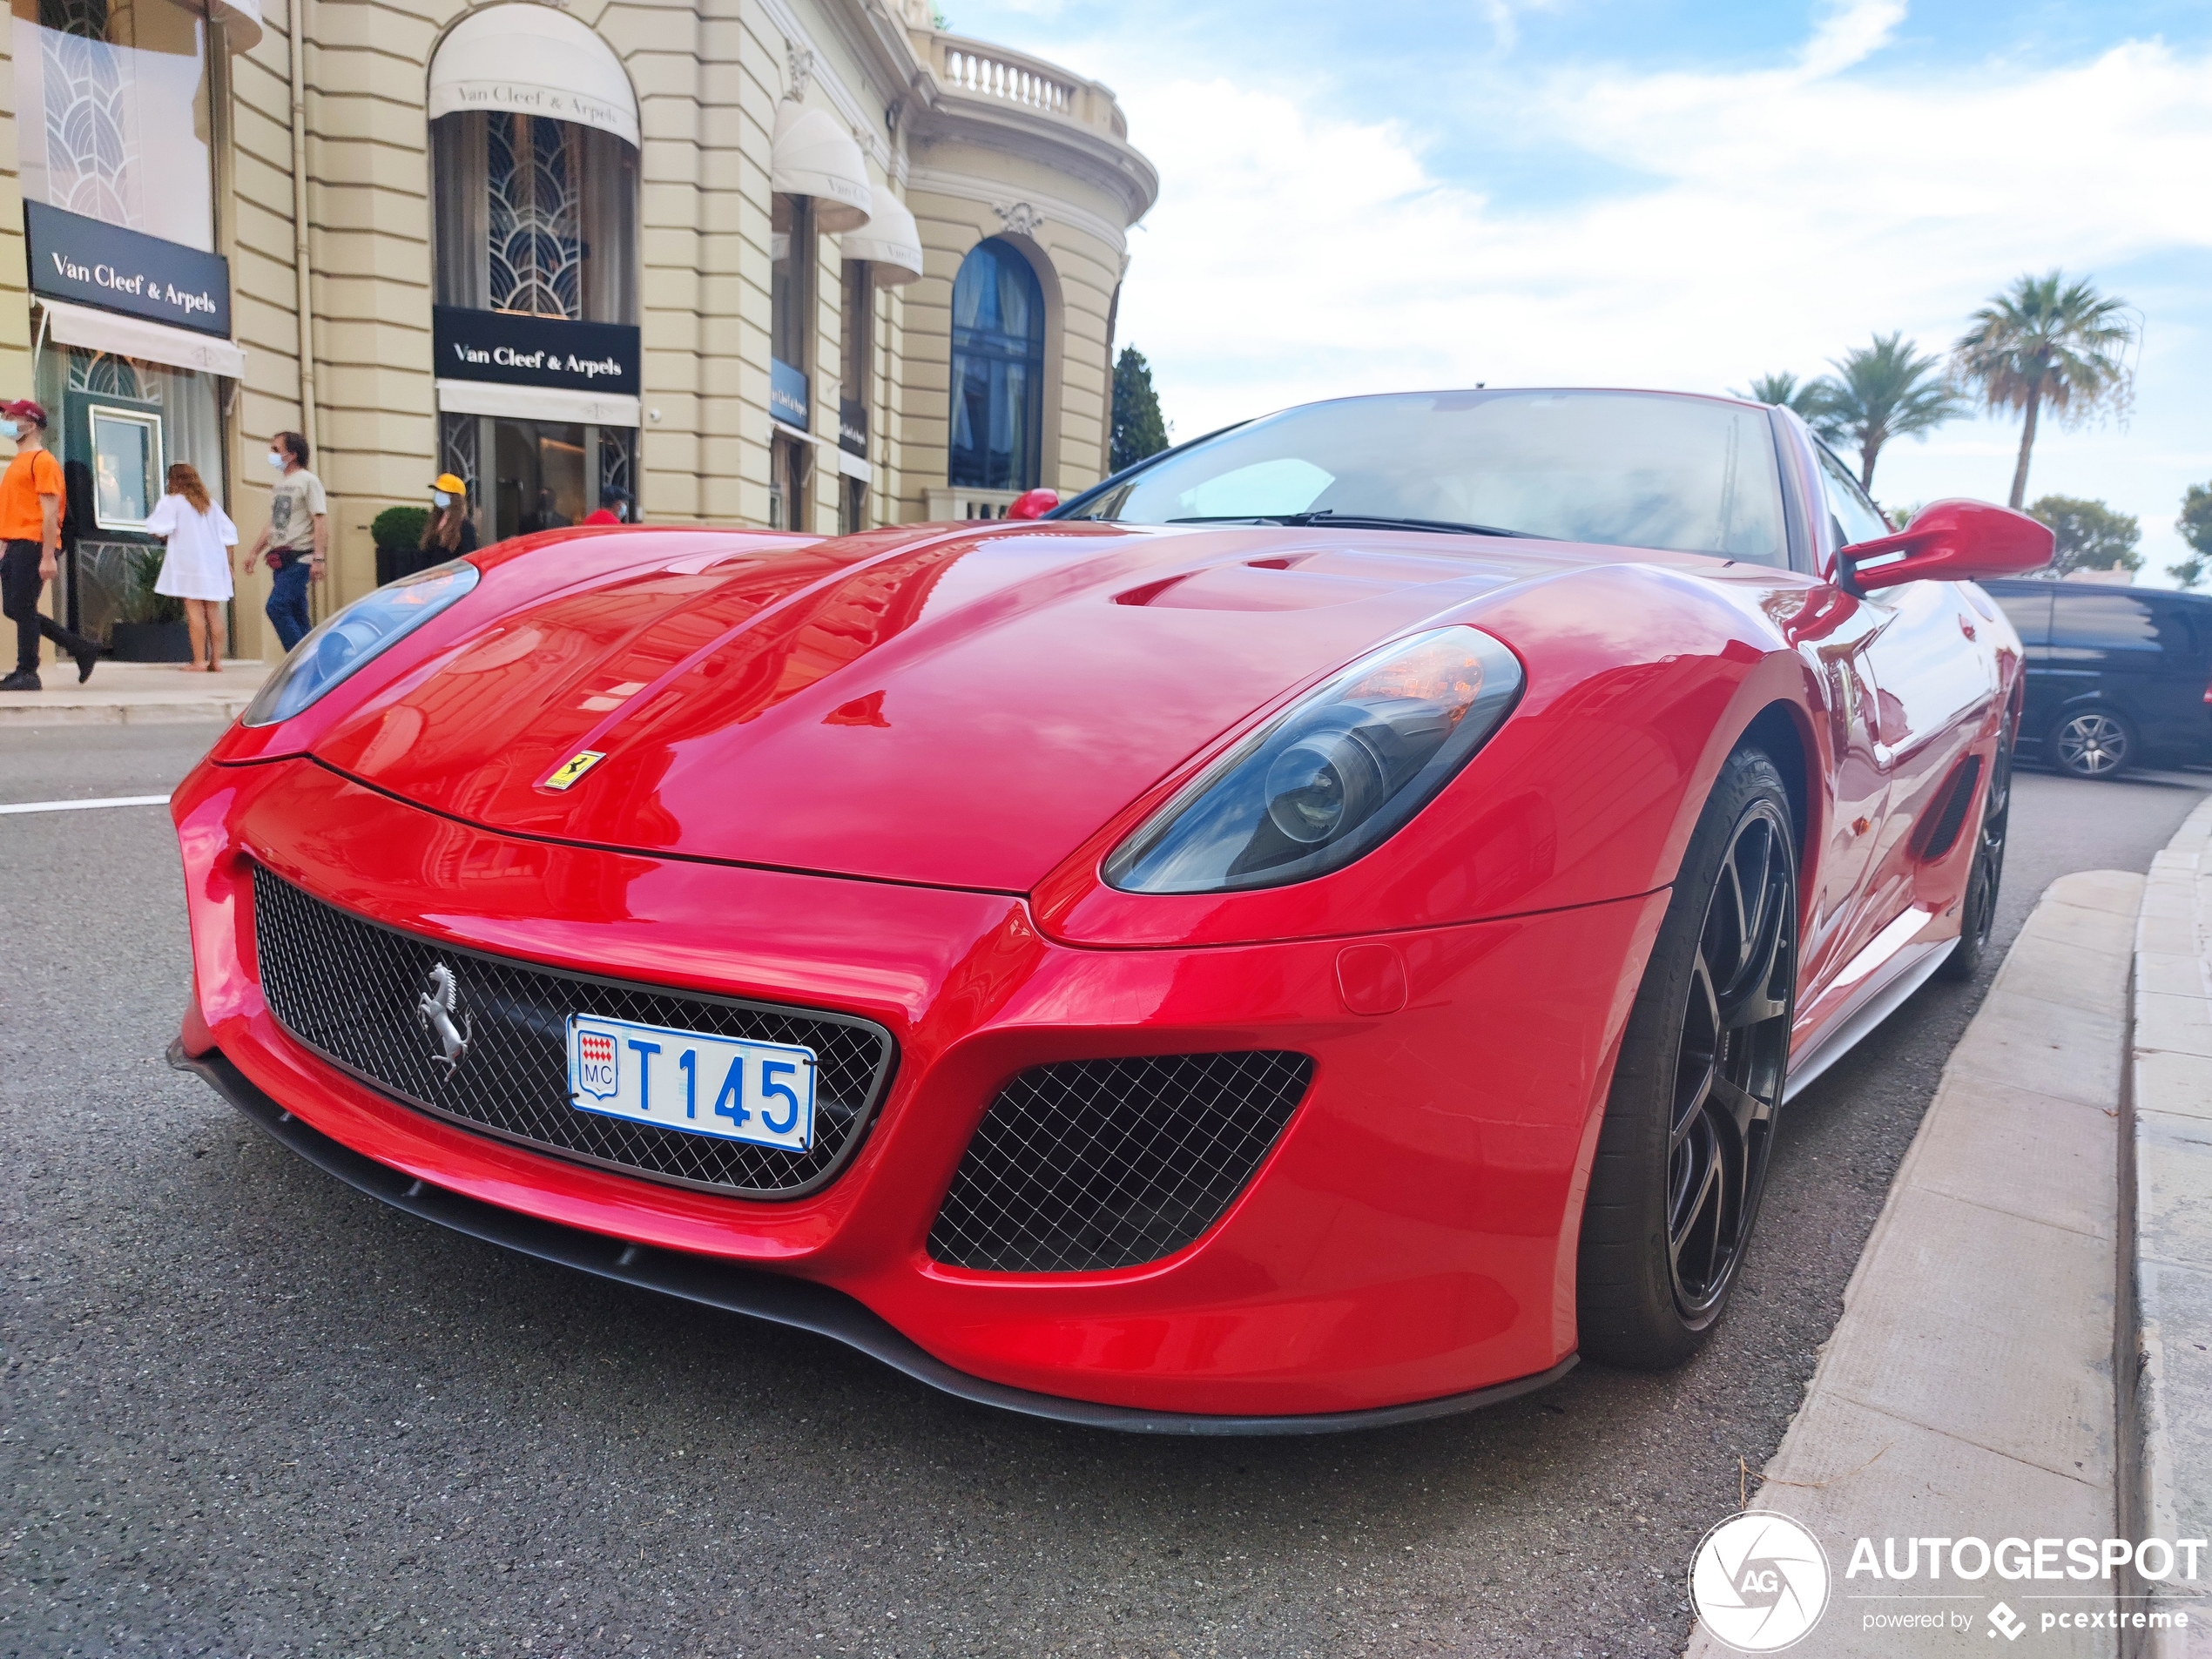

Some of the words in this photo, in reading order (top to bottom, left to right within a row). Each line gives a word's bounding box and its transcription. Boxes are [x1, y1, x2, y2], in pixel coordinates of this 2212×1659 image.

[459, 87, 488, 102] Van
[493, 86, 544, 106] Cleef
[550, 98, 563, 111] &
[570, 98, 618, 124] Arpels
[51, 252, 90, 283] Van
[94, 264, 145, 295] Cleef
[147, 281, 161, 300] &
[165, 283, 217, 314] Arpels
[453, 342, 490, 364] Van
[493, 347, 544, 368] Cleef
[547, 354, 562, 371] &
[565, 354, 622, 378] Arpels
[585, 1063, 613, 1084] MC
[628, 1039, 799, 1134] T145
